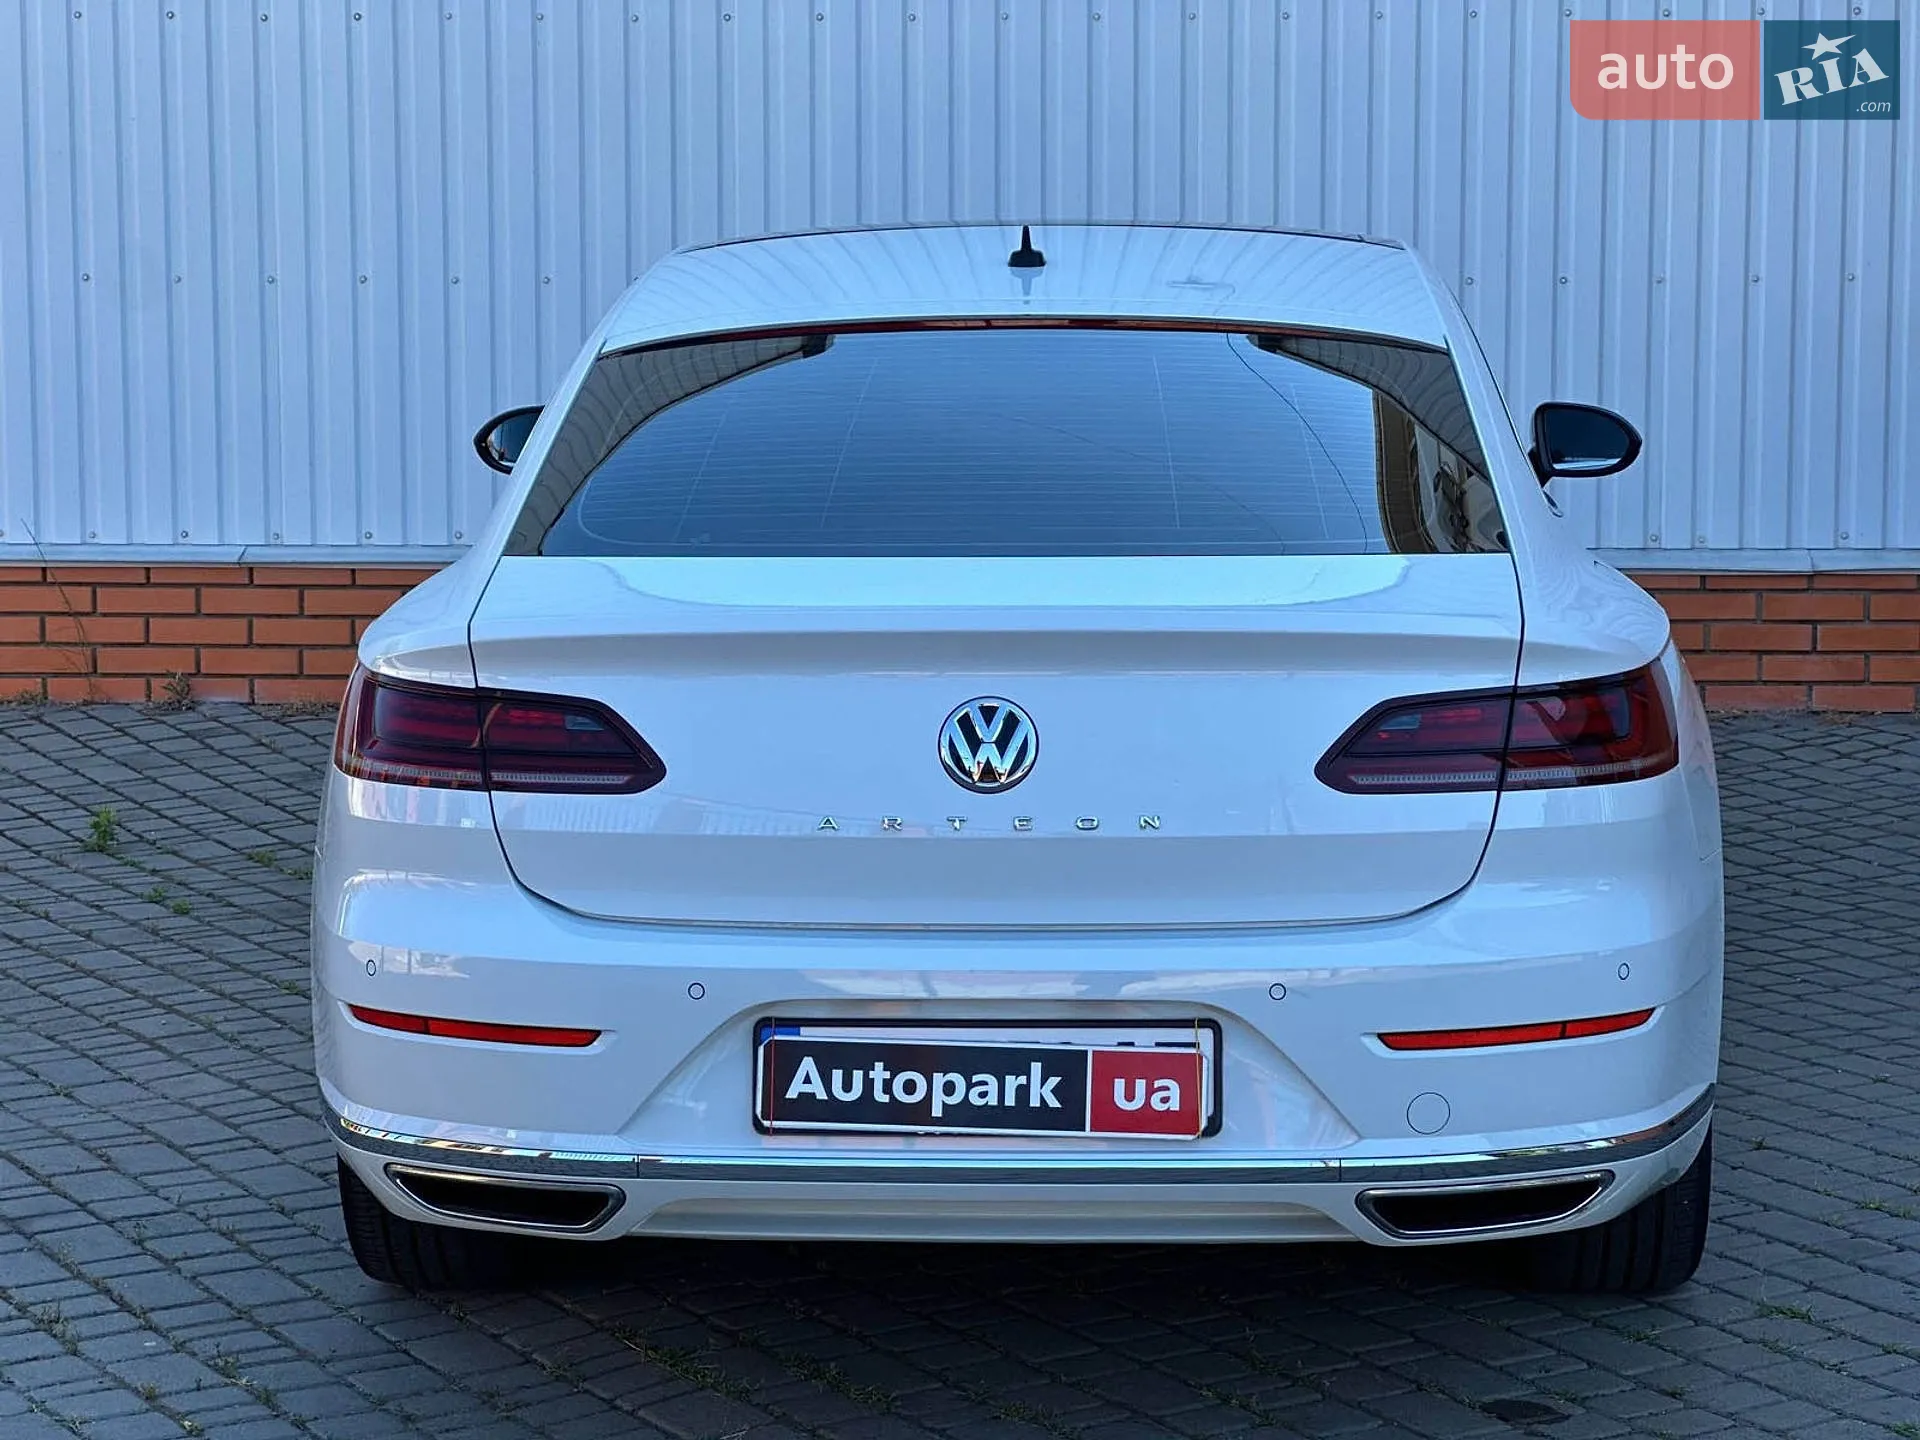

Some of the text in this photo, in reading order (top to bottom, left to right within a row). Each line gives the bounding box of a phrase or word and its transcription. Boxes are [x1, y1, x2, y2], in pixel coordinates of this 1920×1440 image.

[817, 815, 1161, 832] ARTEON
[785, 1056, 1181, 1118] Autopark ua
